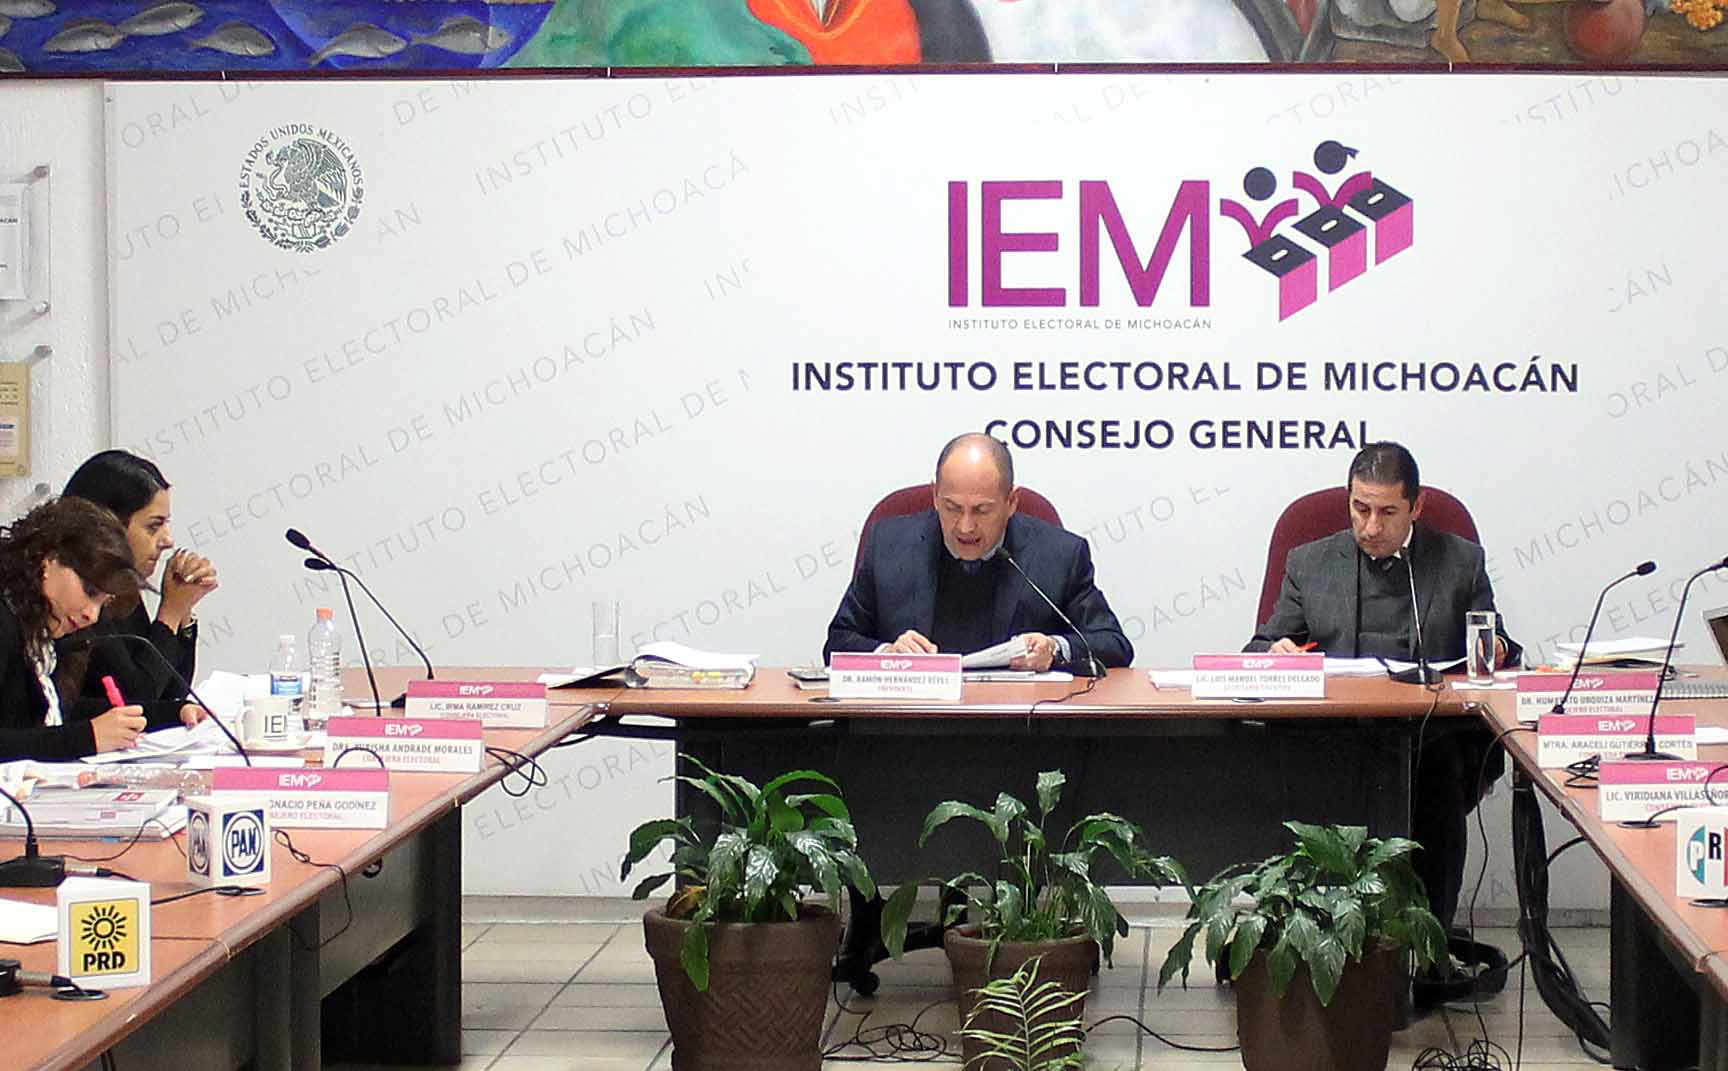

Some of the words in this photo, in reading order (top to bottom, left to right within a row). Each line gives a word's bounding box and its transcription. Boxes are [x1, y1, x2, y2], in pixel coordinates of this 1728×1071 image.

[240, 137, 269, 188] ESTADOS
[270, 123, 313, 140] UNIDOS
[317, 128, 364, 186] MEXICANOS
[947, 180, 1211, 308] IEM
[302, 279, 498, 384] ELECTORAL
[505, 247, 553, 289] DE
[948, 319, 1018, 329] INSTITUTO
[1023, 319, 1099, 329] ELECTORAL
[1105, 319, 1121, 329] DE
[1127, 317, 1212, 329] MICHOACÁN
[791, 361, 997, 392] INSTITUTO
[1014, 361, 1241, 392] ELECTORAL
[1257, 361, 1309, 392] DE
[1323, 355, 1579, 393] MICHOACÁN
[984, 419, 1175, 450] CONSEJO
[1189, 419, 1369, 450] GENERAL
[477, 410, 672, 516] ELECTORAL
[680, 380, 729, 420] DE
[187, 445, 379, 548] ELECTORAL
[387, 414, 434, 454] DE
[442, 599, 489, 640] DE
[459, 685, 480, 695] IEM
[501, 703, 522, 711] CRUZ
[384, 723, 407, 736] IEM
[1598, 720, 1620, 731] IEM
[392, 743, 432, 753] ANDRADE
[434, 744, 473, 754] MORALES
[279, 774, 302, 787] IEM
[1666, 768, 1691, 781] IEM
[307, 798, 332, 811] PEÑA
[1606, 792, 1622, 801] LIC.
[1624, 791, 1672, 801] VIRIDIANA
[232, 828, 256, 858] PAN
[83, 951, 126, 972] PRD
